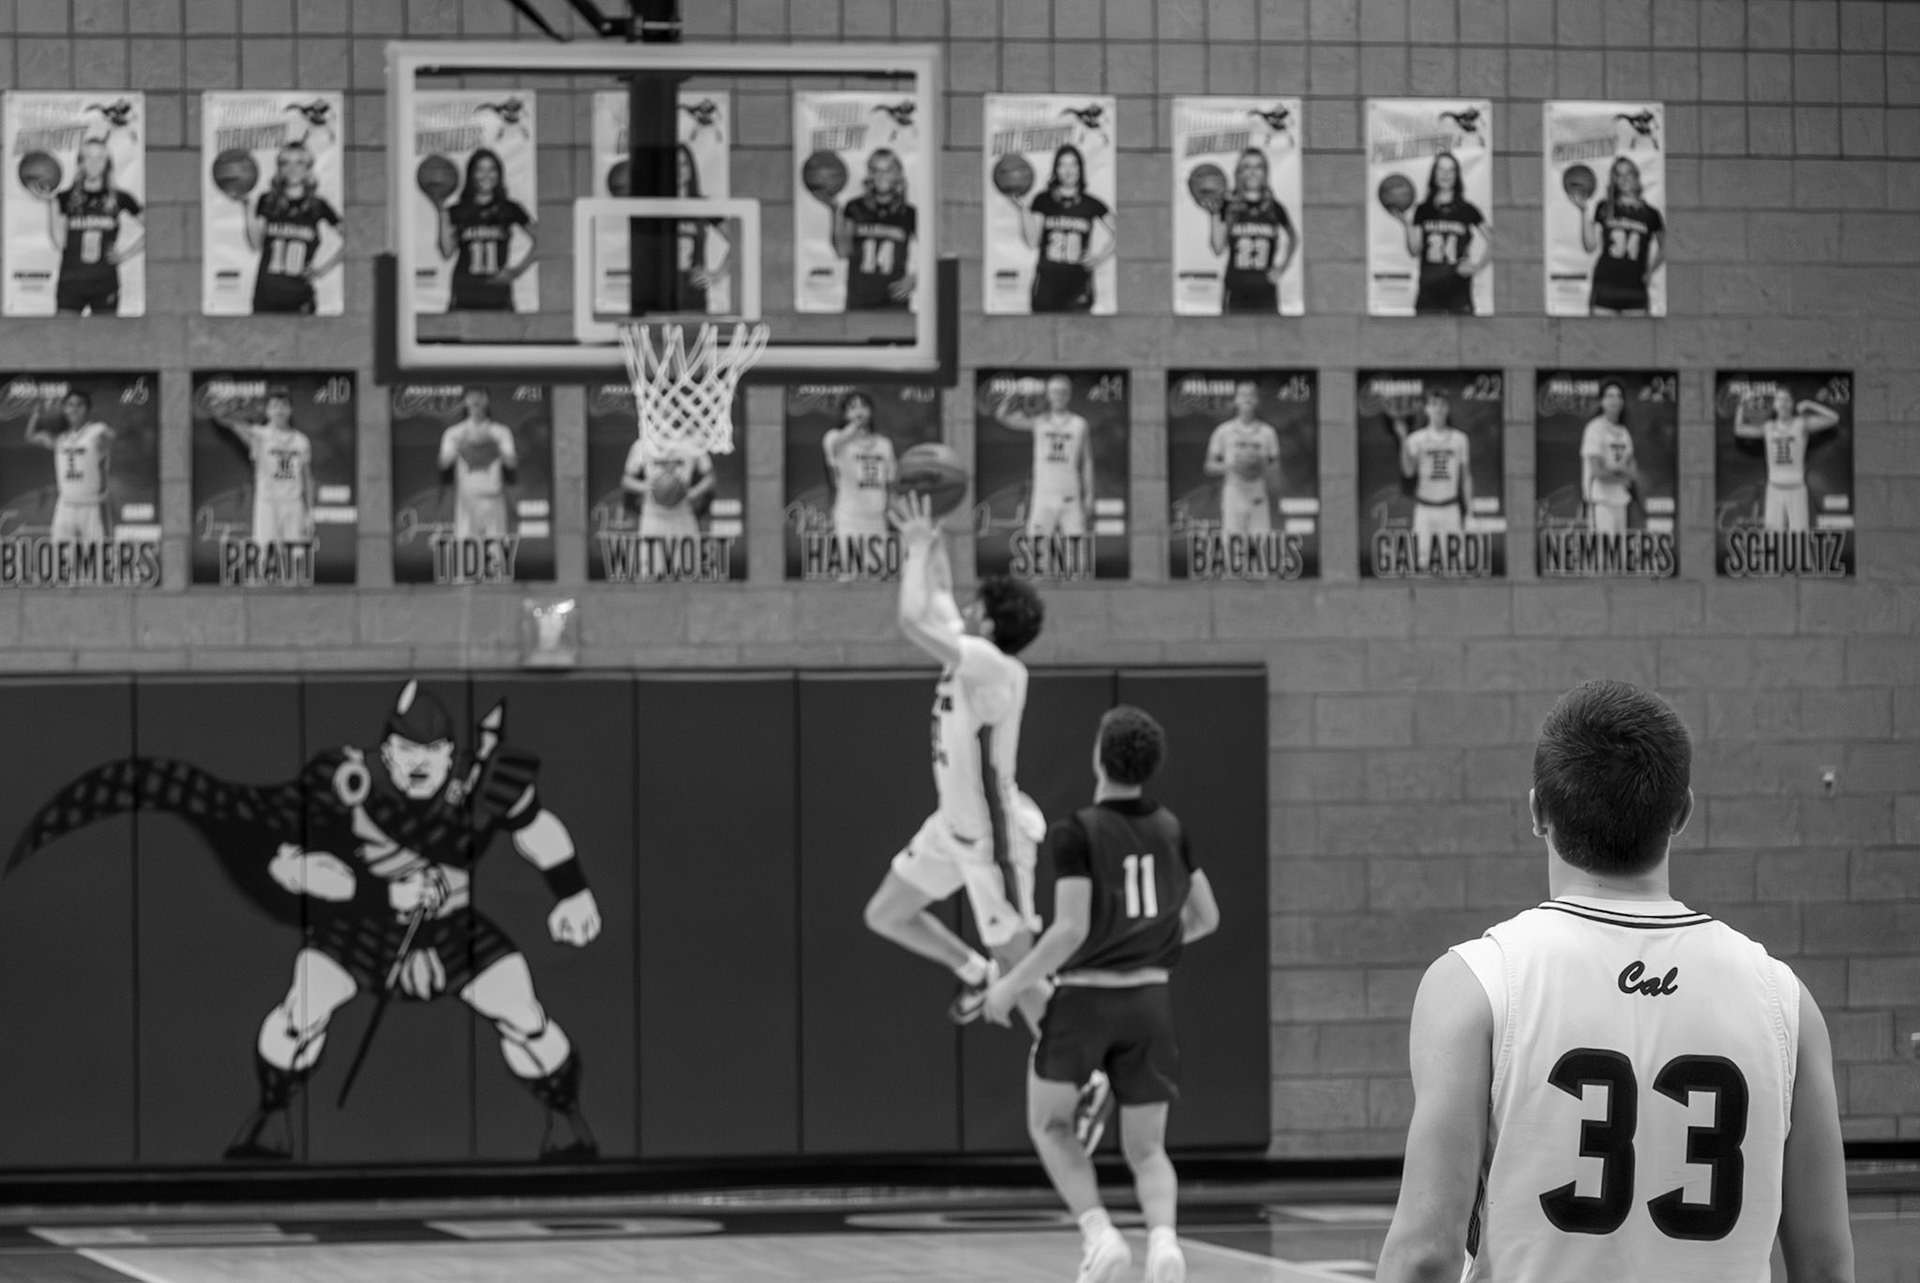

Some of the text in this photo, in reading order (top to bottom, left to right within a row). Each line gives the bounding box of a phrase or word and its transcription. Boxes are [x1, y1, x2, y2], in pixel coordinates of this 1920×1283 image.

[313, 375, 351, 405] #10
[1461, 373, 1501, 401] #22
[1, 535, 161, 587] BLOEMERS
[221, 536, 319, 586] PRATT
[430, 533, 520, 583] TIDEY
[599, 531, 735, 582] WITVOET
[800, 531, 905, 581] HANSO
[1010, 529, 1096, 580] SENTI
[1188, 529, 1303, 579] BACKUS
[1372, 528, 1492, 578] GALARDI
[1540, 528, 1675, 578] NEMMERS
[1726, 528, 1846, 577] SCHULTZ
[1123, 854, 1157, 918] 11
[1616, 959, 1679, 997] Cal
[1539, 1047, 1749, 1242] 33
